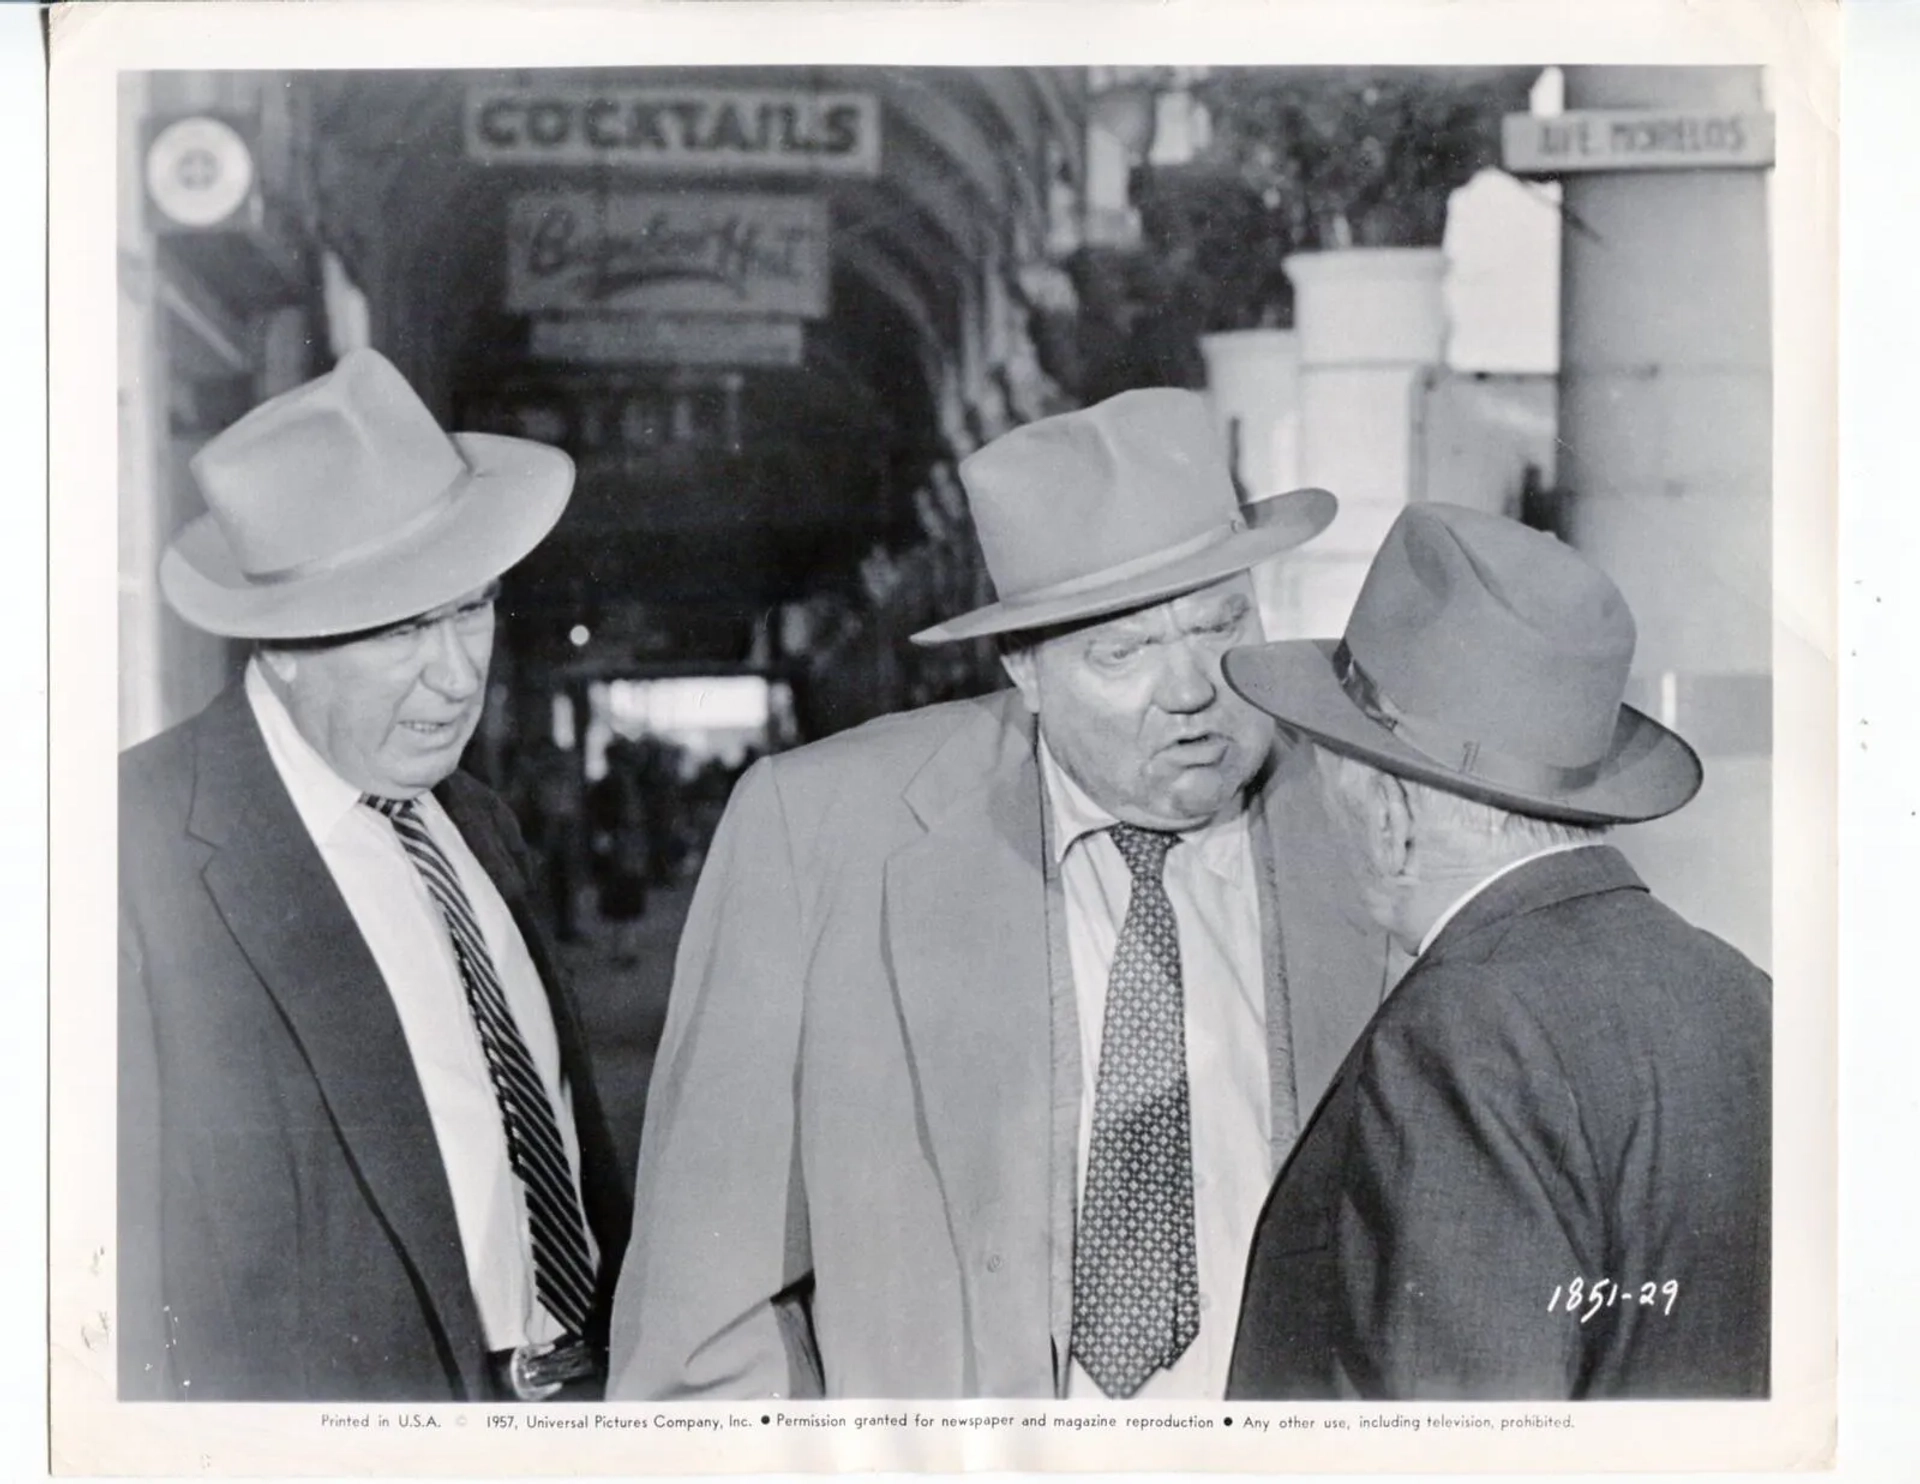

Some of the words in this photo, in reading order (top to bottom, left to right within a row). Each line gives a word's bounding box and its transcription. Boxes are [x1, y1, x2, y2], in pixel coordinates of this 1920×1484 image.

[476, 98, 862, 155] COCKTAILS
[1547, 1275, 1679, 1324] 1851-29
[321, 1413, 370, 1428] Printed
[378, 1414, 390, 1428] in
[398, 1414, 442, 1429] U.S.A.
[486, 1415, 519, 1430] 1957,
[526, 1414, 589, 1430] Universal
[594, 1414, 648, 1429] Pictures
[653, 1414, 723, 1431] Company,
[729, 1413, 752, 1428] Inc.
[776, 1412, 847, 1428] Permission
[853, 1413, 908, 1429] granted
[913, 1413, 935, 1428] for
[941, 1415, 1015, 1429] newspaper
[1020, 1413, 1047, 1428] and
[1053, 1414, 1117, 1431] magazine
[1125, 1414, 1214, 1431] reproduction
[1242, 1415, 1271, 1432] Any
[1278, 1415, 1316, 1430] other
[1323, 1418, 1351, 1430] use,
[1359, 1414, 1421, 1431] including
[1426, 1414, 1495, 1430] television,
[1500, 1414, 1575, 1431] prohibited.
